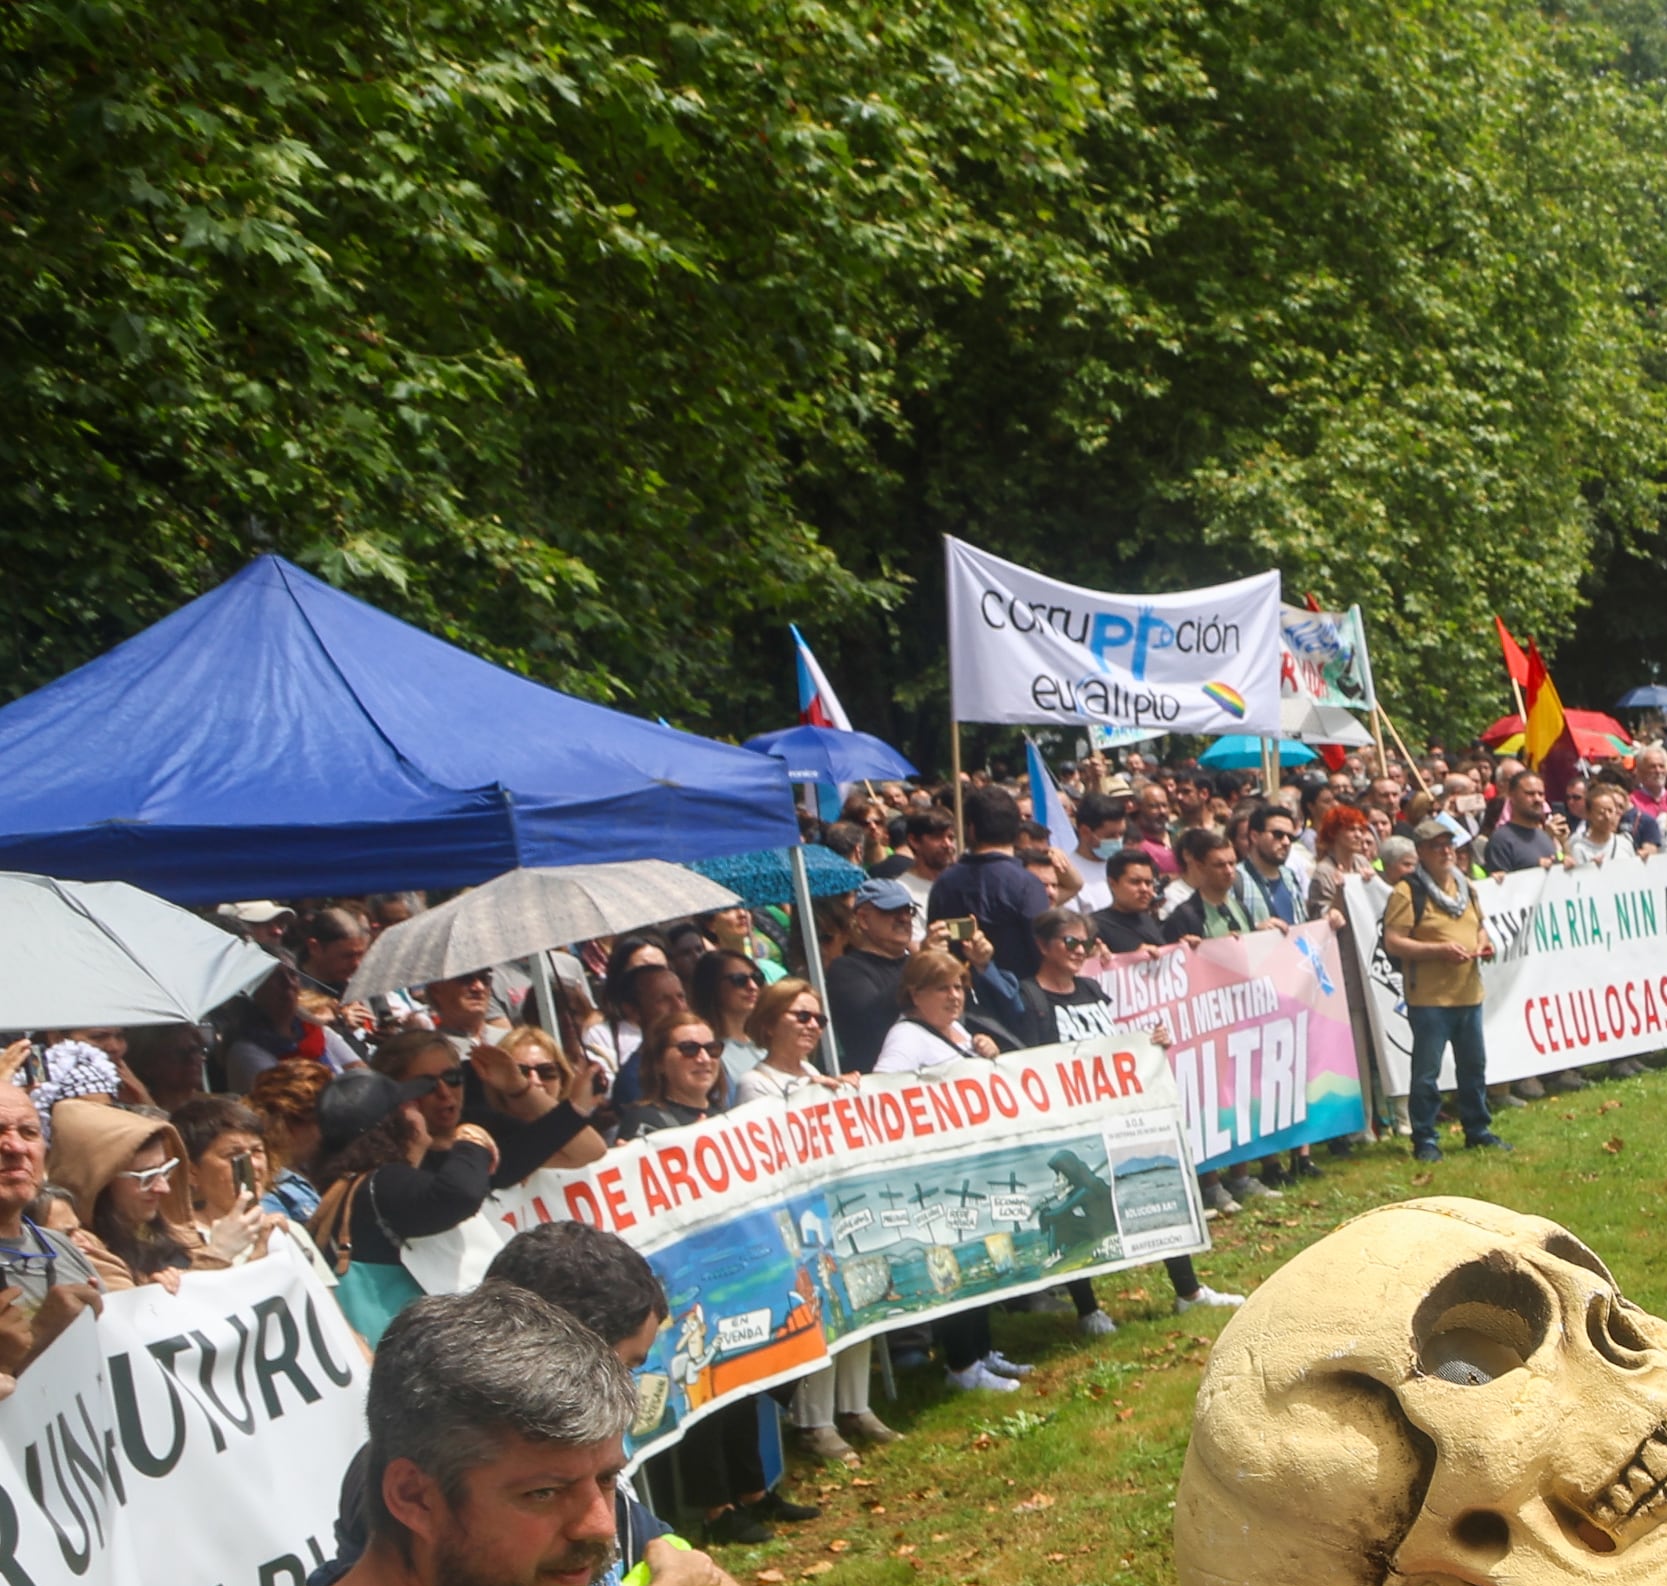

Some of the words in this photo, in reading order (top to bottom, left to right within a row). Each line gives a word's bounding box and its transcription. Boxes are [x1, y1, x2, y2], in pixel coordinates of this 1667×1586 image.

[1534, 900, 1564, 952] NA
[1614, 888, 1658, 942] NIN
[1178, 1001, 1192, 1040] A
[1193, 974, 1279, 1032] MENTIRA
[1173, 1010, 1309, 1166] ALTRI
[563, 1166, 637, 1232] DE
[638, 1117, 791, 1217] AROUSA
[785, 1076, 1019, 1165] DEFENDENDO
[1020, 1067, 1050, 1114] O
[1056, 1051, 1144, 1107] MAR
[723, 1325, 764, 1345] VENDA
